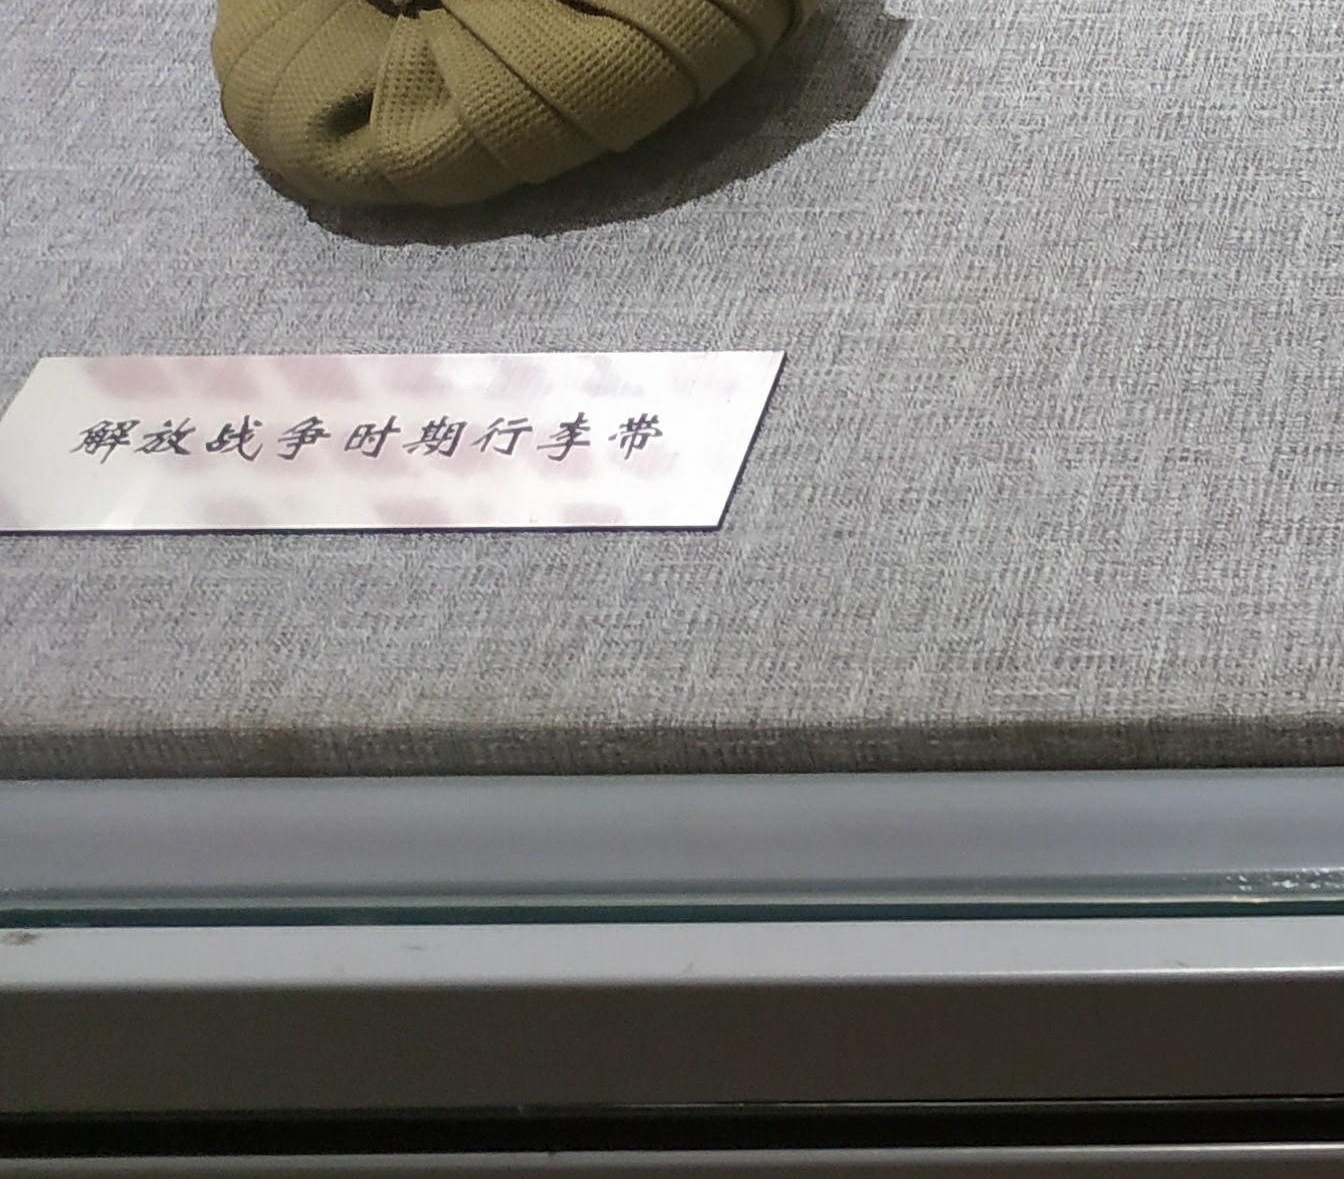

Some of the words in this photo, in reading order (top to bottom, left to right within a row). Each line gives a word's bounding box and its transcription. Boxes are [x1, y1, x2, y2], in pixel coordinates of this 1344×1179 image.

[69, 414, 664, 462] 解放战争时期行李带
